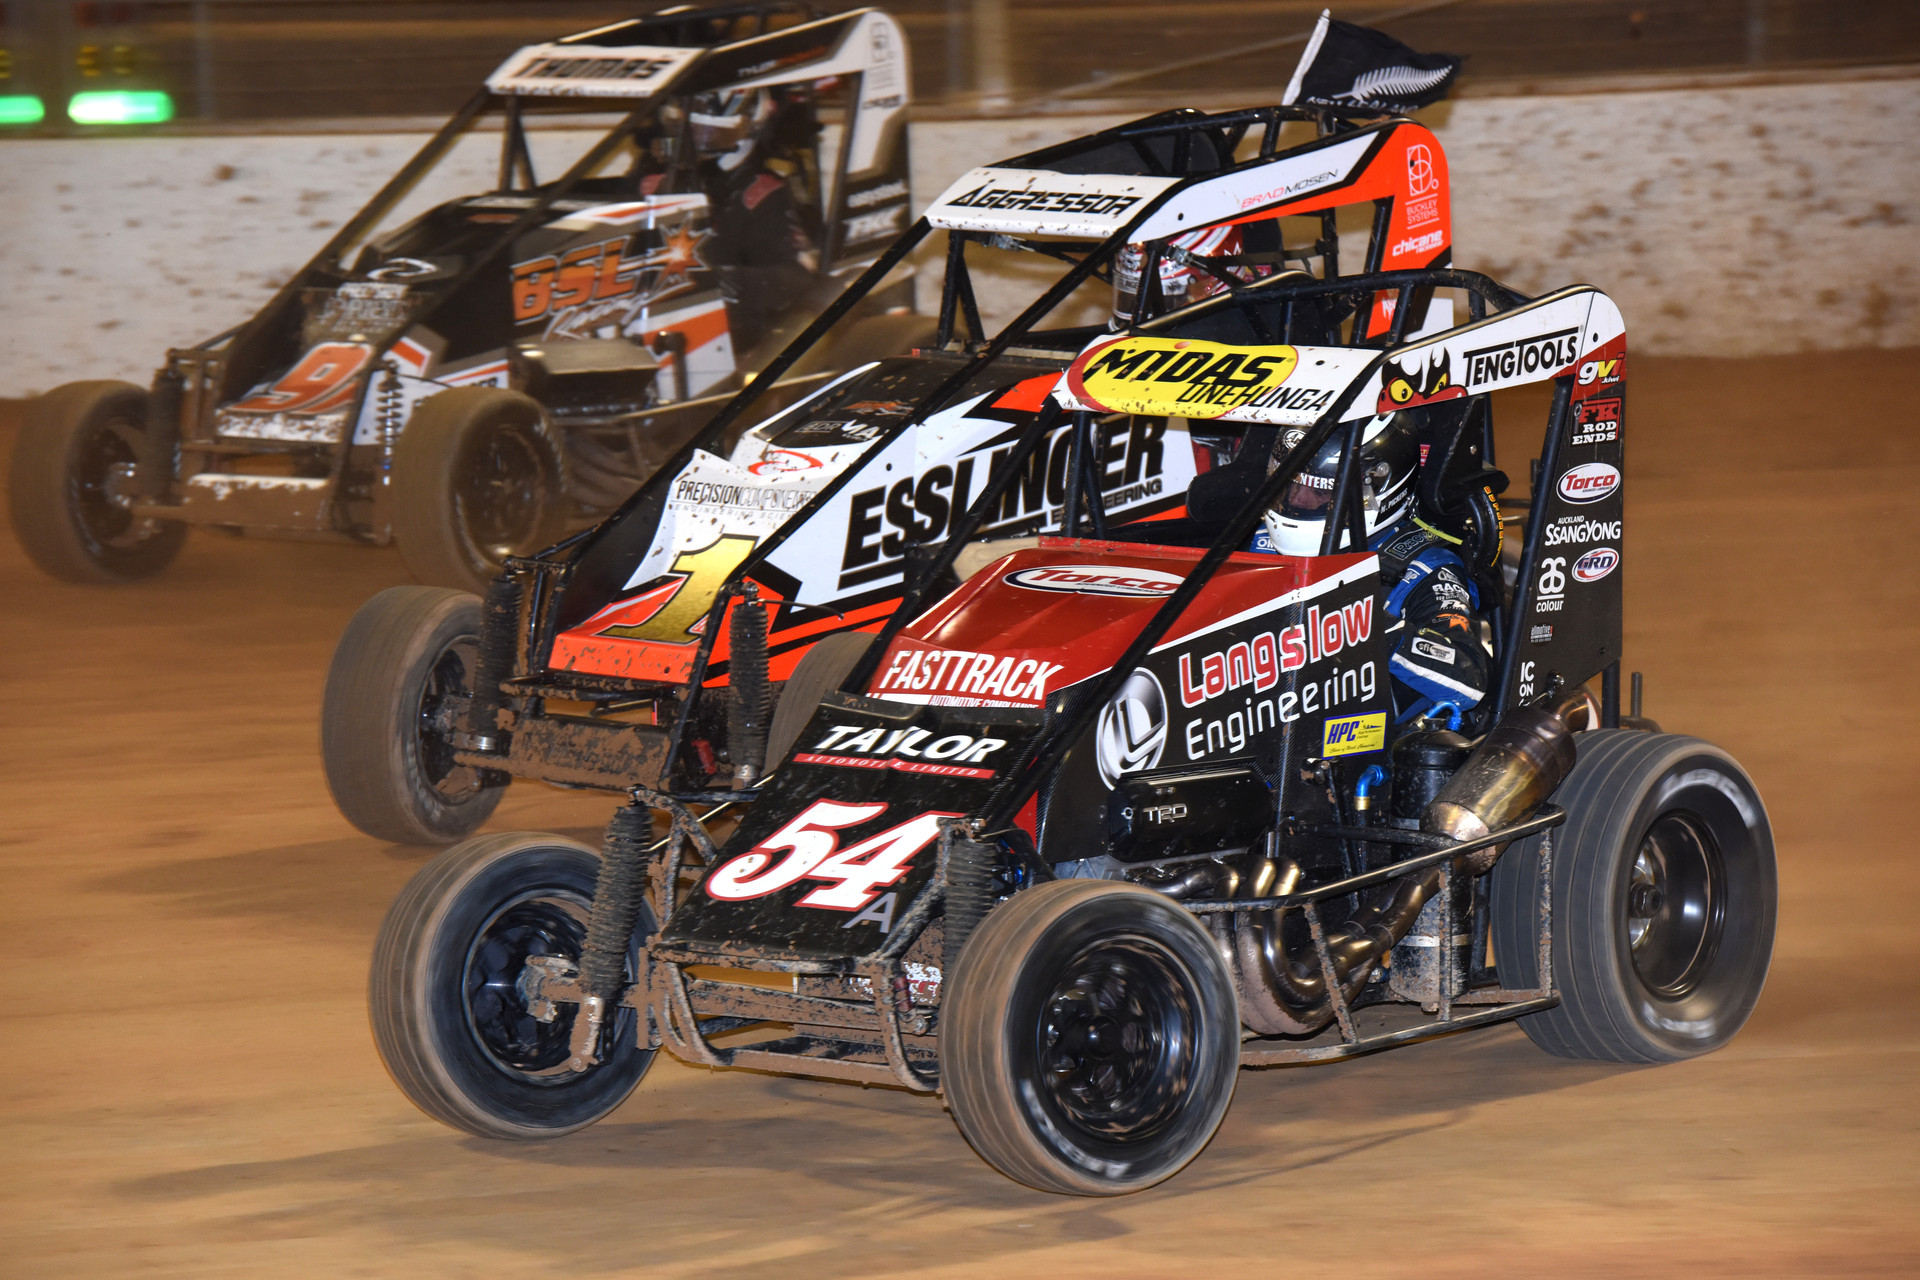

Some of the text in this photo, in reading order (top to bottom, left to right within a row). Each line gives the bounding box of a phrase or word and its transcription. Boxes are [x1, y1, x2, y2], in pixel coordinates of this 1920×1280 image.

[945, 181, 1144, 215] AGGRESSOR
[1406, 199, 1438, 215] BUCKLEY
[1407, 209, 1439, 225] SYSTEMS
[1392, 230, 1443, 257] chicane
[510, 235, 642, 326] BSL
[224, 342, 374, 414] 9
[1082, 348, 1288, 388] MIDAS
[1578, 352, 1625, 386] gvi
[1176, 383, 1335, 411] ONEHUNGA
[1579, 402, 1619, 424] FK
[1572, 432, 1616, 446] ENDS
[1582, 421, 1617, 433] ROD
[1565, 474, 1616, 491] Torco
[1558, 515, 1584, 524] AUCKLAND
[591, 533, 760, 646] 1
[1029, 570, 1182, 591] Torco
[1536, 600, 1564, 613] colour
[1178, 595, 1374, 709] Langslow
[878, 650, 1065, 700] FASTTRACK
[1520, 661, 1536, 682] IC
[930, 694, 981, 708] AUTOMOTIVE
[1519, 683, 1534, 697] ON
[1185, 661, 1376, 760] Engineering
[813, 725, 1007, 763] TAYLOR
[1326, 721, 1360, 745] HPC
[805, 755, 979, 776] AUTOMOTIE LIMITED
[1142, 803, 1188, 824] TRD
[705, 797, 967, 912] 54
[842, 892, 897, 934] A
